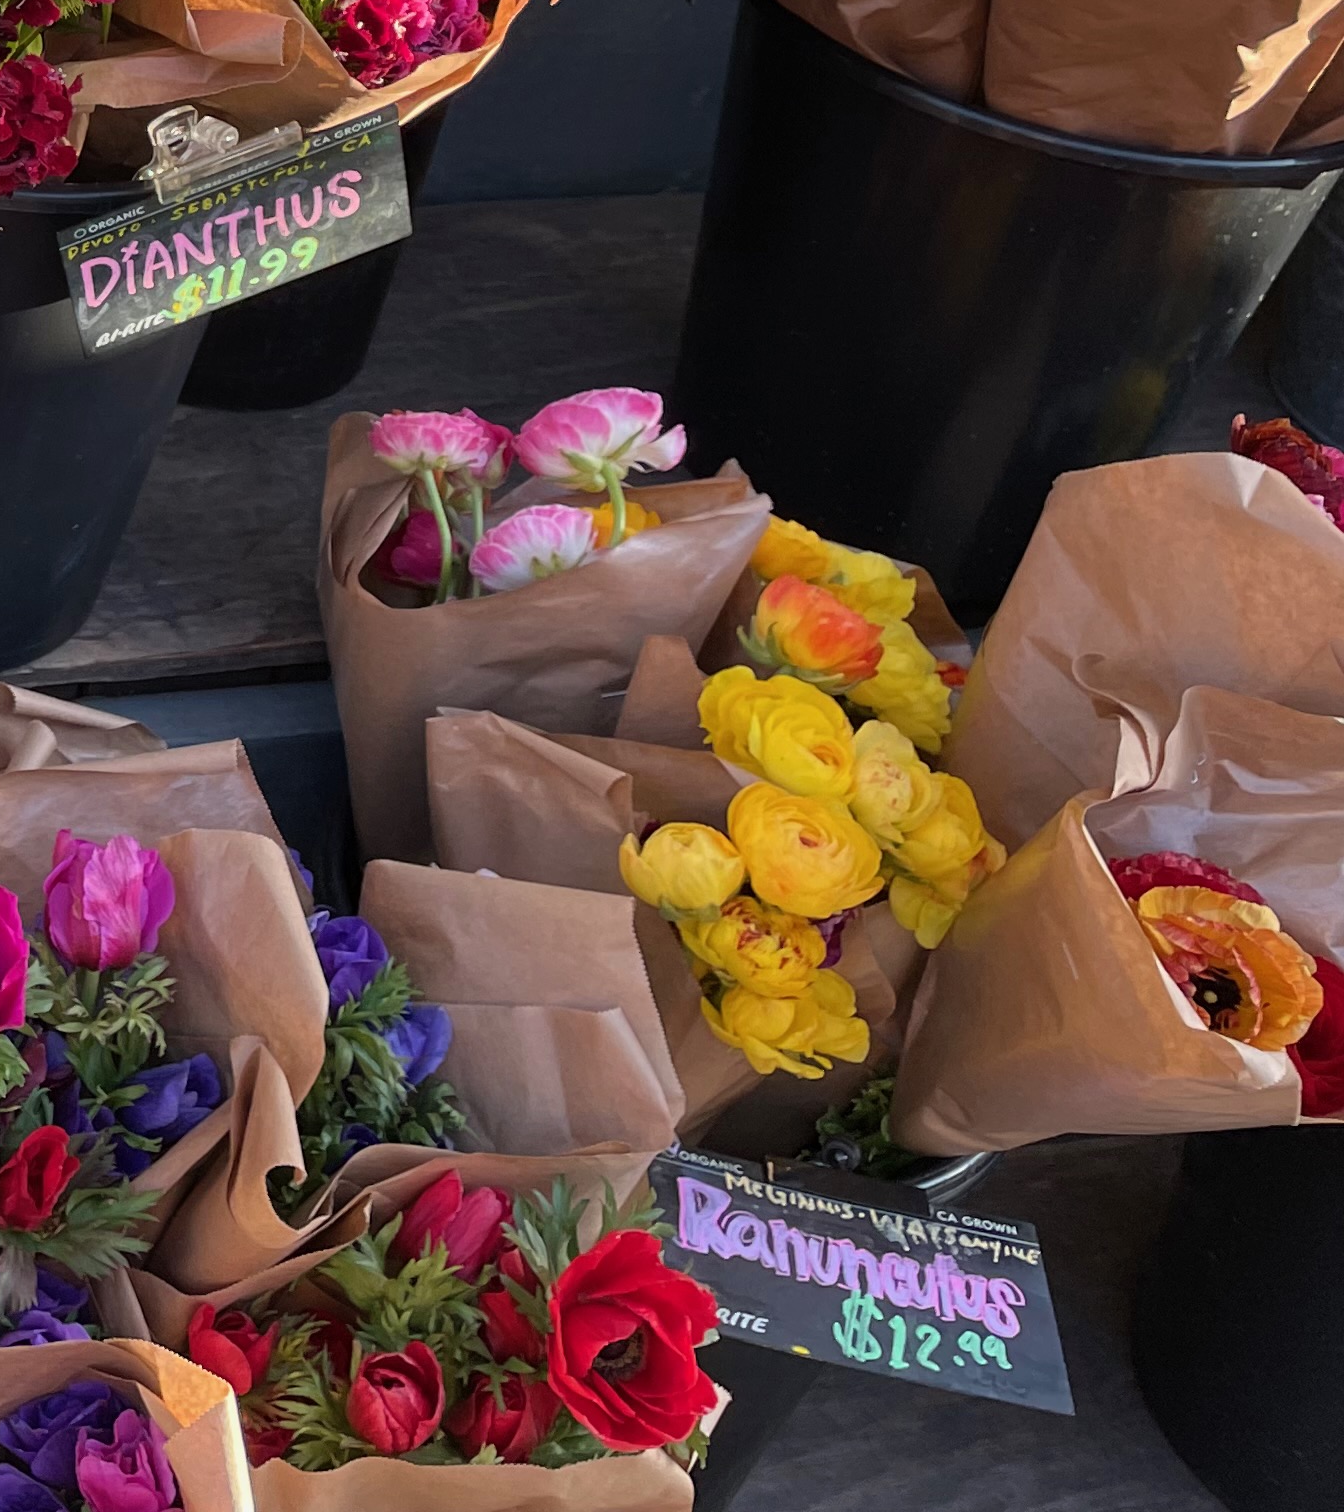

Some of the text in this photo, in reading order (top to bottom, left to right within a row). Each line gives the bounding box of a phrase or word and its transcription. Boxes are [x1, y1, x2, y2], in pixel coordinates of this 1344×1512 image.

[312, 114, 383, 149] CA GROWN
[66, 221, 142, 262] DEVOTO
[340, 135, 372, 154] CA
[87, 205, 146, 235] ORGANIC
[168, 235, 320, 325] $11.99
[678, 1150, 745, 1176] ORGANIC
[935, 1210, 1018, 1236] CA GROWN
[673, 1176, 1027, 1339] Ranunculus
[831, 1289, 1014, 1372] $12.99
